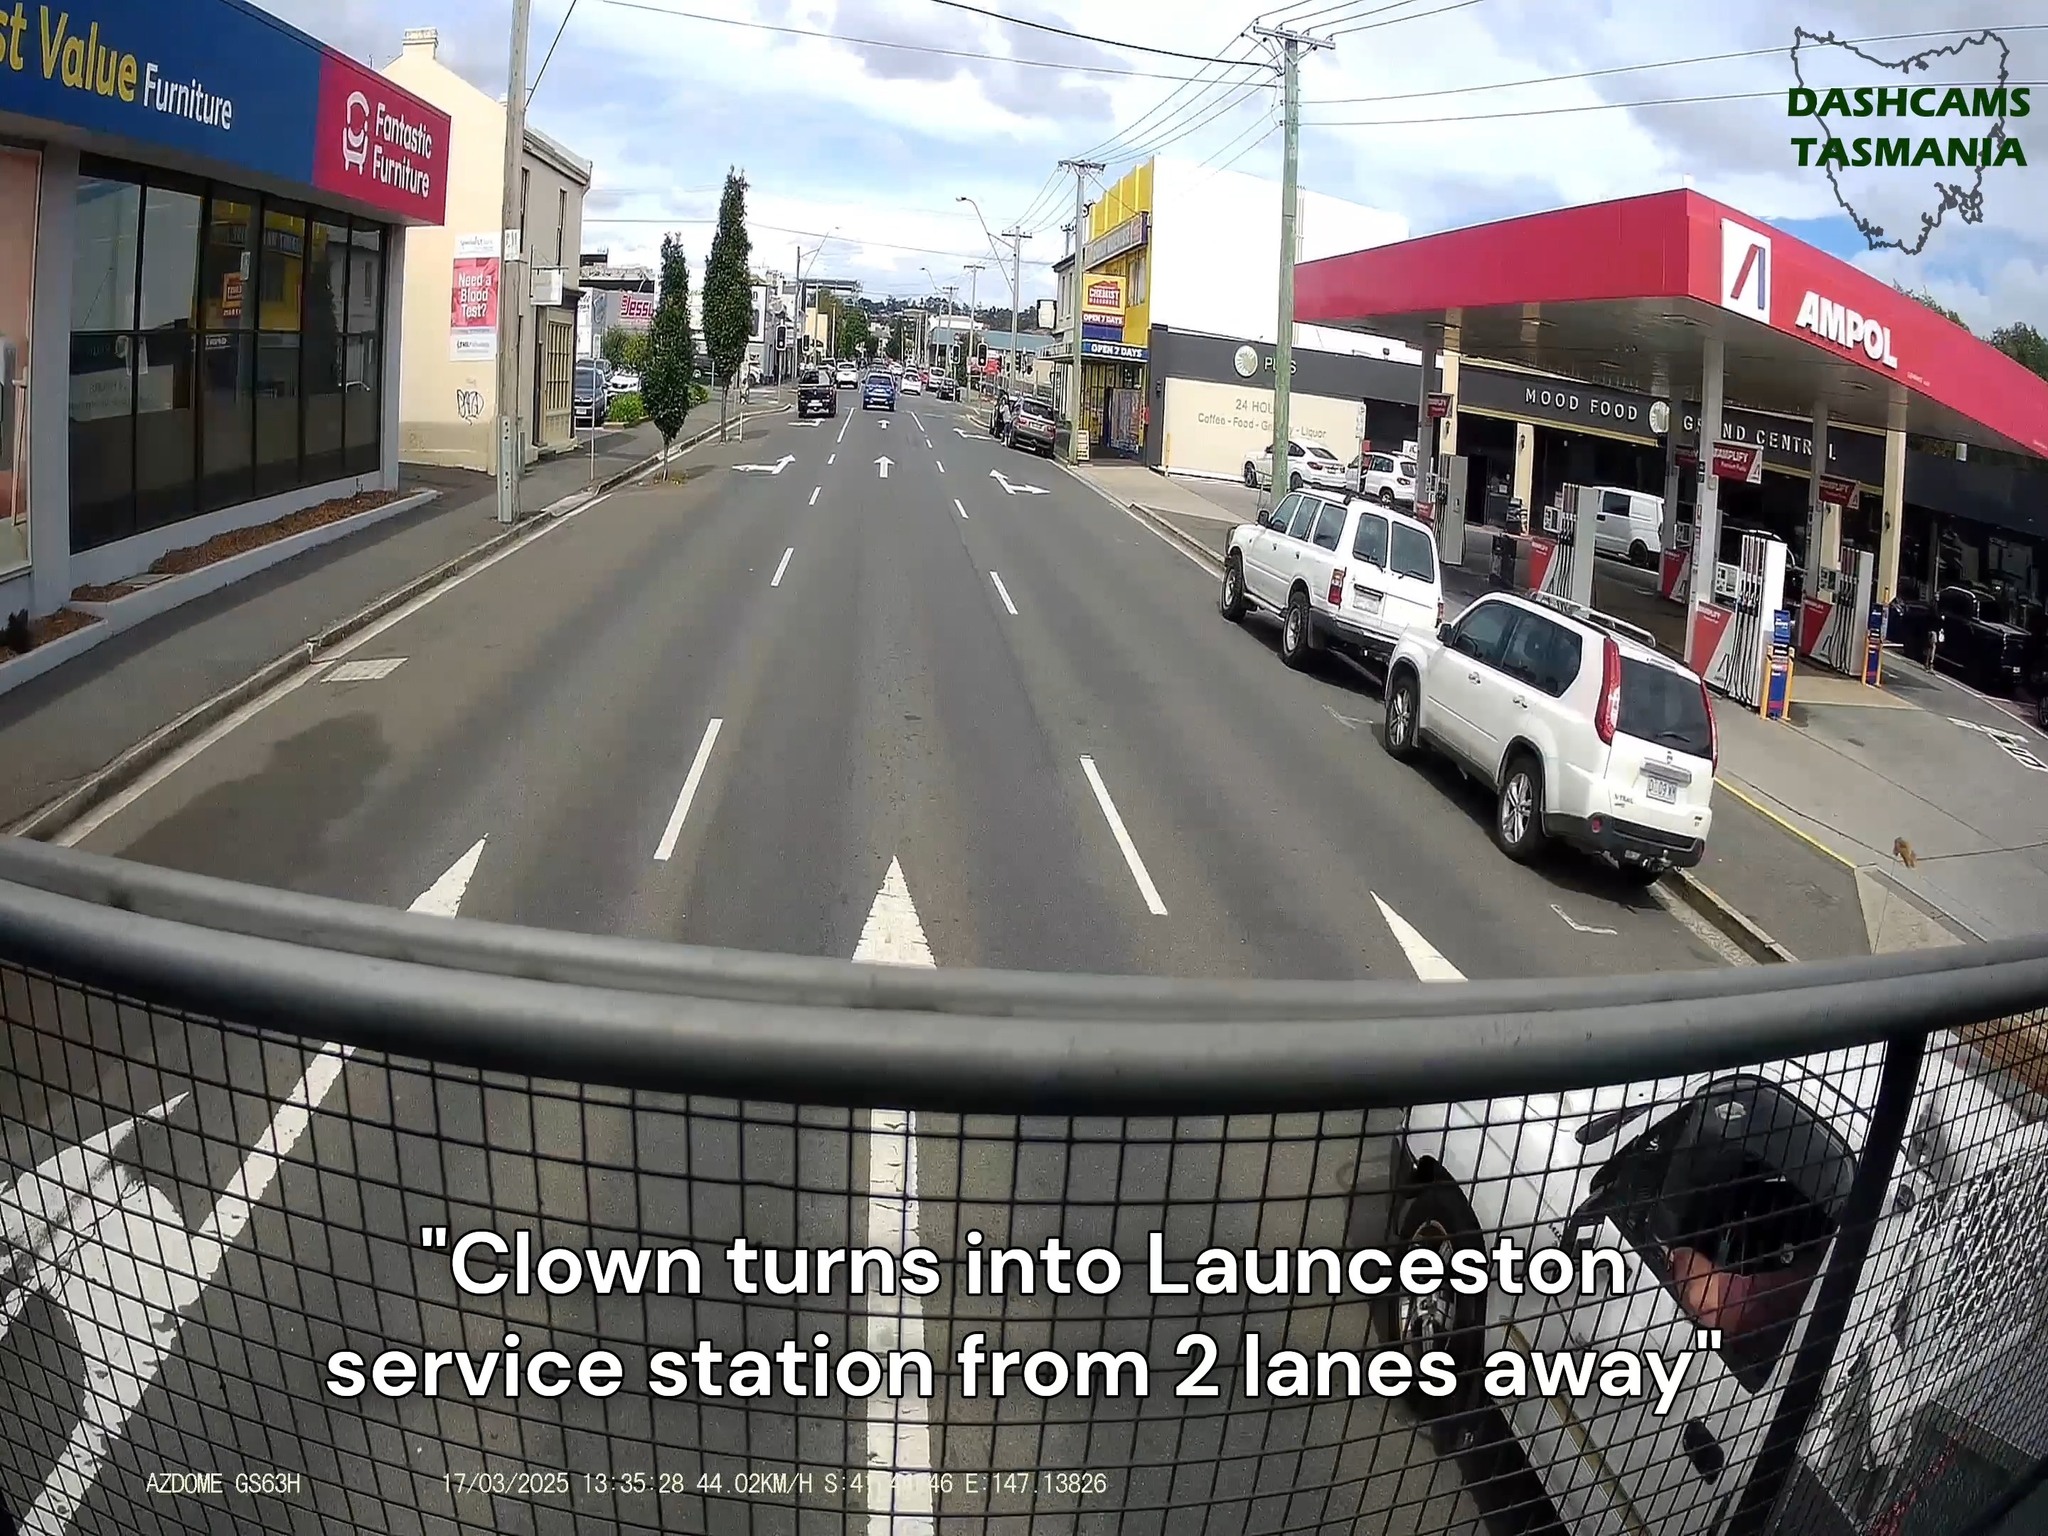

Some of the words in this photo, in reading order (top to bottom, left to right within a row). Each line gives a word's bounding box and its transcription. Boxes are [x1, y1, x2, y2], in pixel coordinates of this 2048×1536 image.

[39, 5, 137, 102] Value
[143, 62, 232, 130] Furniture
[376, 102, 432, 159] Fantastic
[373, 144, 430, 198] Furniture
[458, 272, 483, 287] Need
[486, 275, 492, 286] a
[461, 287, 488, 302] Blood
[1089, 288, 1120, 301] CHEMIST
[461, 303, 487, 318] Test?
[1083, 313, 1100, 323] OPEN
[1795, 290, 1897, 369] AMPOL
[1091, 343, 1114, 355] OPEN
[1114, 345, 1120, 356] 7
[1120, 347, 1143, 358] DAYS
[1236, 399, 1248, 411] 24
[1525, 388, 1579, 410] MOOD
[1590, 399, 1638, 421] FOOD
[1198, 412, 1226, 426] Coffee
[1233, 416, 1254, 430] Food
[1301, 426, 1328, 440] Liquor
[1756, 429, 1837, 461] CENTRL
